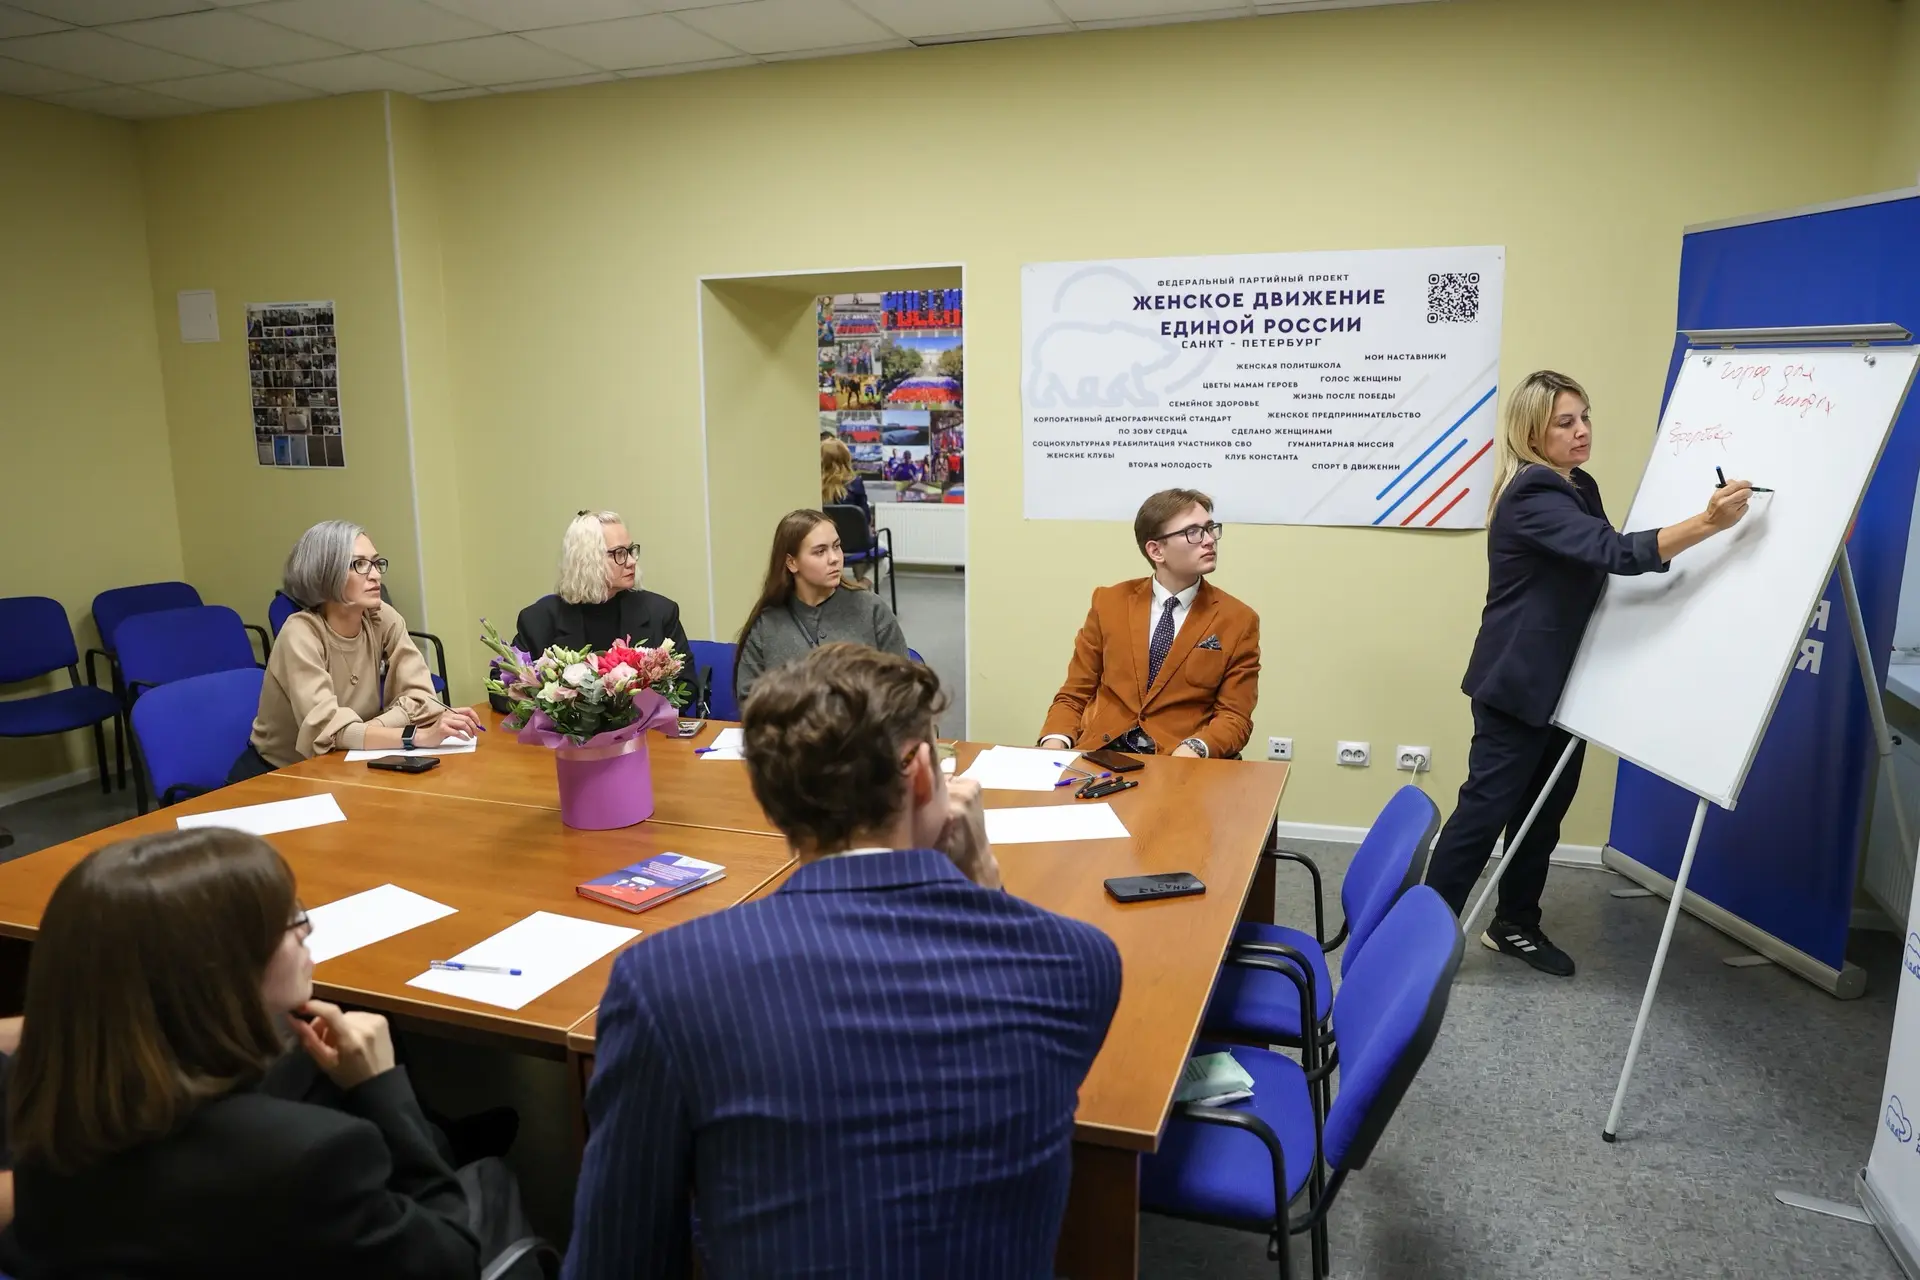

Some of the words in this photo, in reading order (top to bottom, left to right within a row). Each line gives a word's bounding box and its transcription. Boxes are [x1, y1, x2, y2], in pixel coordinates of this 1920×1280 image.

[1157, 276, 1235, 288] ФЕДЕРАЛЬНЫЙ
[1239, 273, 1304, 284] ПАРТИЙНЫЙ
[1308, 274, 1350, 282] ПРОЕКТ
[1132, 292, 1244, 311] ЖЕНСКОЕ
[1252, 288, 1385, 311] ДВИЖЕНИЕ
[1160, 313, 1254, 339] ЕДИНОЙ
[1264, 316, 1362, 334] РОССИИ
[1181, 339, 1224, 349] САНКТ
[1242, 337, 1322, 348] ПЕТЕРБУРГ
[1386, 353, 1447, 361] НАСТАВНИКИ
[1236, 362, 1278, 370] ЖЕНСКАЯ
[1280, 362, 1342, 370] ПОЛИТШКОЛА
[1320, 375, 1350, 383] ГОЛОС
[1352, 375, 1402, 383] ЖЕНЩИНЫ
[1202, 382, 1231, 390] ЦВЕТЫ
[1233, 381, 1264, 389] МАМАМ
[1266, 381, 1299, 389] ГЕРОЕВ
[1325, 392, 1356, 400] ПОСЛЕ
[1358, 392, 1396, 401] ПОБЕДЫ
[1168, 399, 1213, 408] СЕМЕЙНОЕ
[1215, 400, 1260, 408] ЗДОРОВЬЕ
[1033, 414, 1103, 423] КОРПОРАТИВНЫЙ
[1104, 413, 1187, 424] ДЕМОГРАФИЧЕСКИЙ
[1188, 415, 1232, 423] СТАНДАРТ
[1267, 411, 1309, 419] ЖЕНСКОЕ
[1311, 411, 1422, 420] ПРЕДПРИНИМАТЕЛЬСТВО
[1155, 428, 1188, 436] СЕРДЦА
[1231, 428, 1272, 436] СДЕЛАНО
[1274, 428, 1333, 436] ЖЕНЩИНАМИ
[1032, 440, 1111, 448] СОЦИОКУЛЬТУРНАЯ
[1112, 440, 1176, 448] РЕАБИЛИТАЦИЯ
[1177, 440, 1233, 448] УЧАСТНИКОВ
[1234, 440, 1253, 448] СВО
[1224, 453, 1247, 461] КЛУБ
[1248, 453, 1299, 461] КОНСТАНТА
[1128, 461, 1159, 469] ВТОРАЯ
[1160, 461, 1213, 470] МОЛОДОСТЬ
[1350, 463, 1401, 471] ДВИЖЕНИИ
